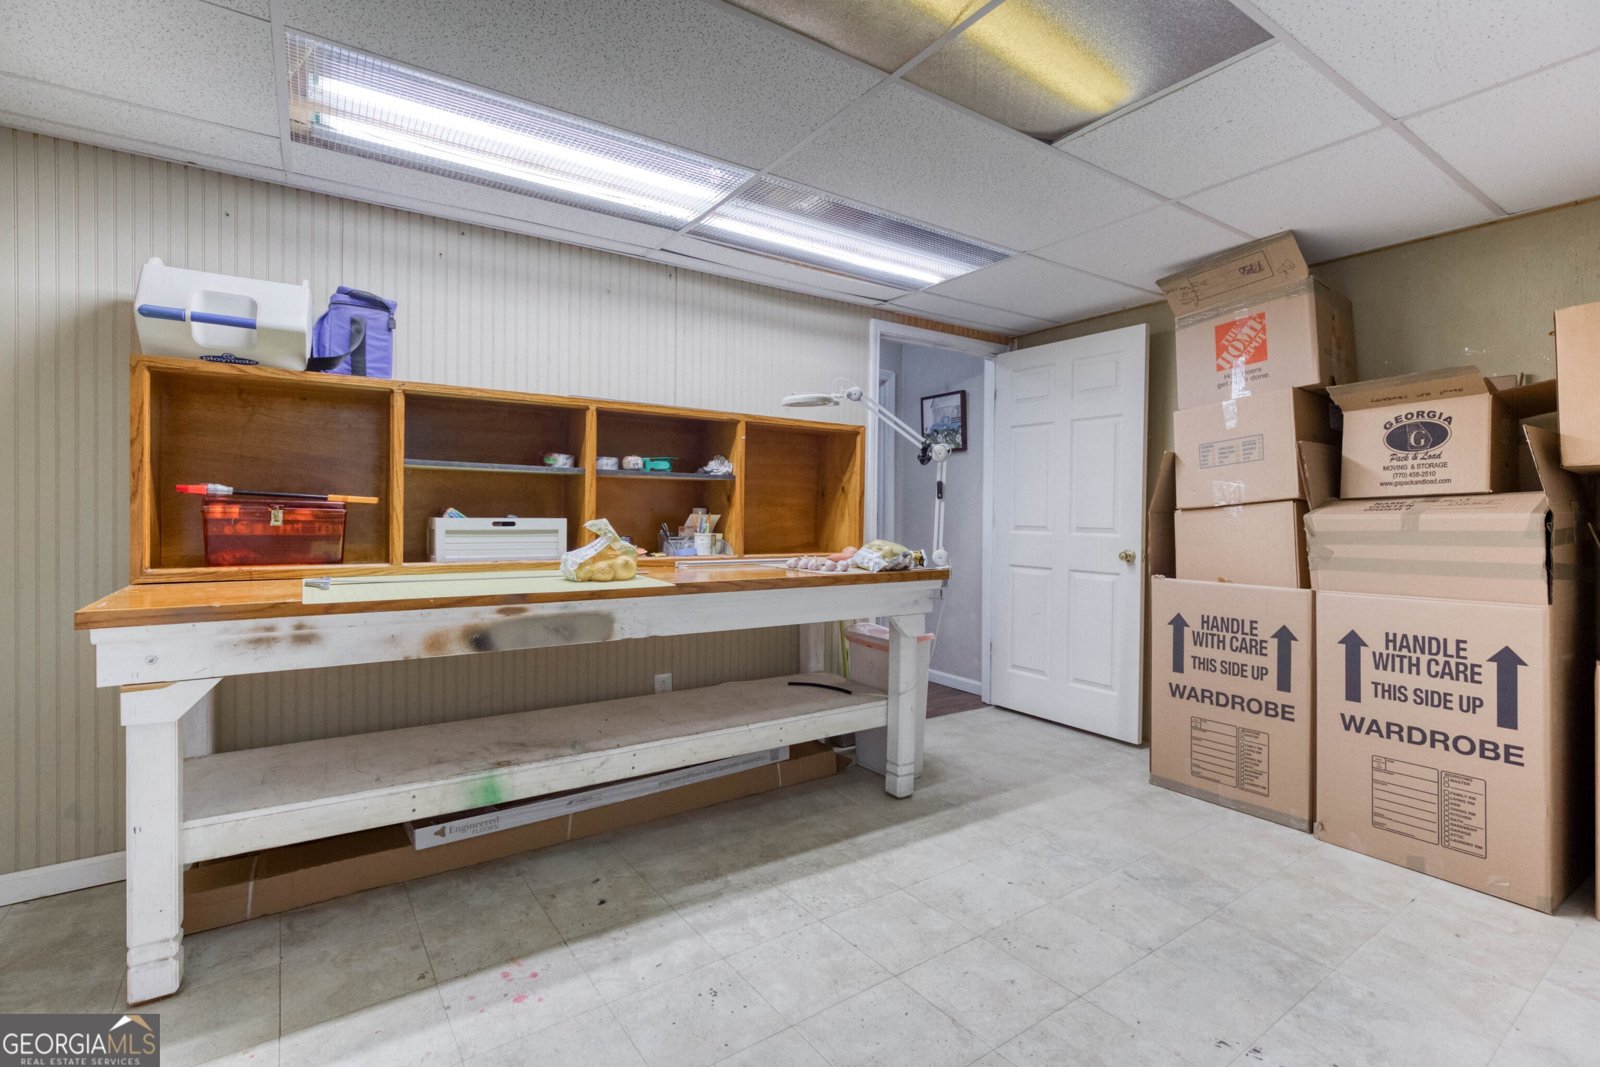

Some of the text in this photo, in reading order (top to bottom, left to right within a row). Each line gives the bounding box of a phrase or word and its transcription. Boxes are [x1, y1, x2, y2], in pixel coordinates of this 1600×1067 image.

[1217, 314, 1266, 371] HOME
[1383, 410, 1453, 430] GEORGIA
[1410, 430, 1426, 447] G
[1390, 451, 1443, 462] Pack & Load
[1201, 614, 1259, 637] HANDLE
[1192, 630, 1268, 657] WITH CARE
[1385, 631, 1468, 660] HANDLE
[1191, 655, 1269, 681] THIS SIDE UP
[1372, 651, 1483, 685] WITH CARE
[1168, 682, 1295, 722] WARDROBE
[1371, 681, 1484, 714] THIS SIDE UP
[1340, 712, 1525, 767] WARDROBE
[449, 815, 500, 834] Engineered
